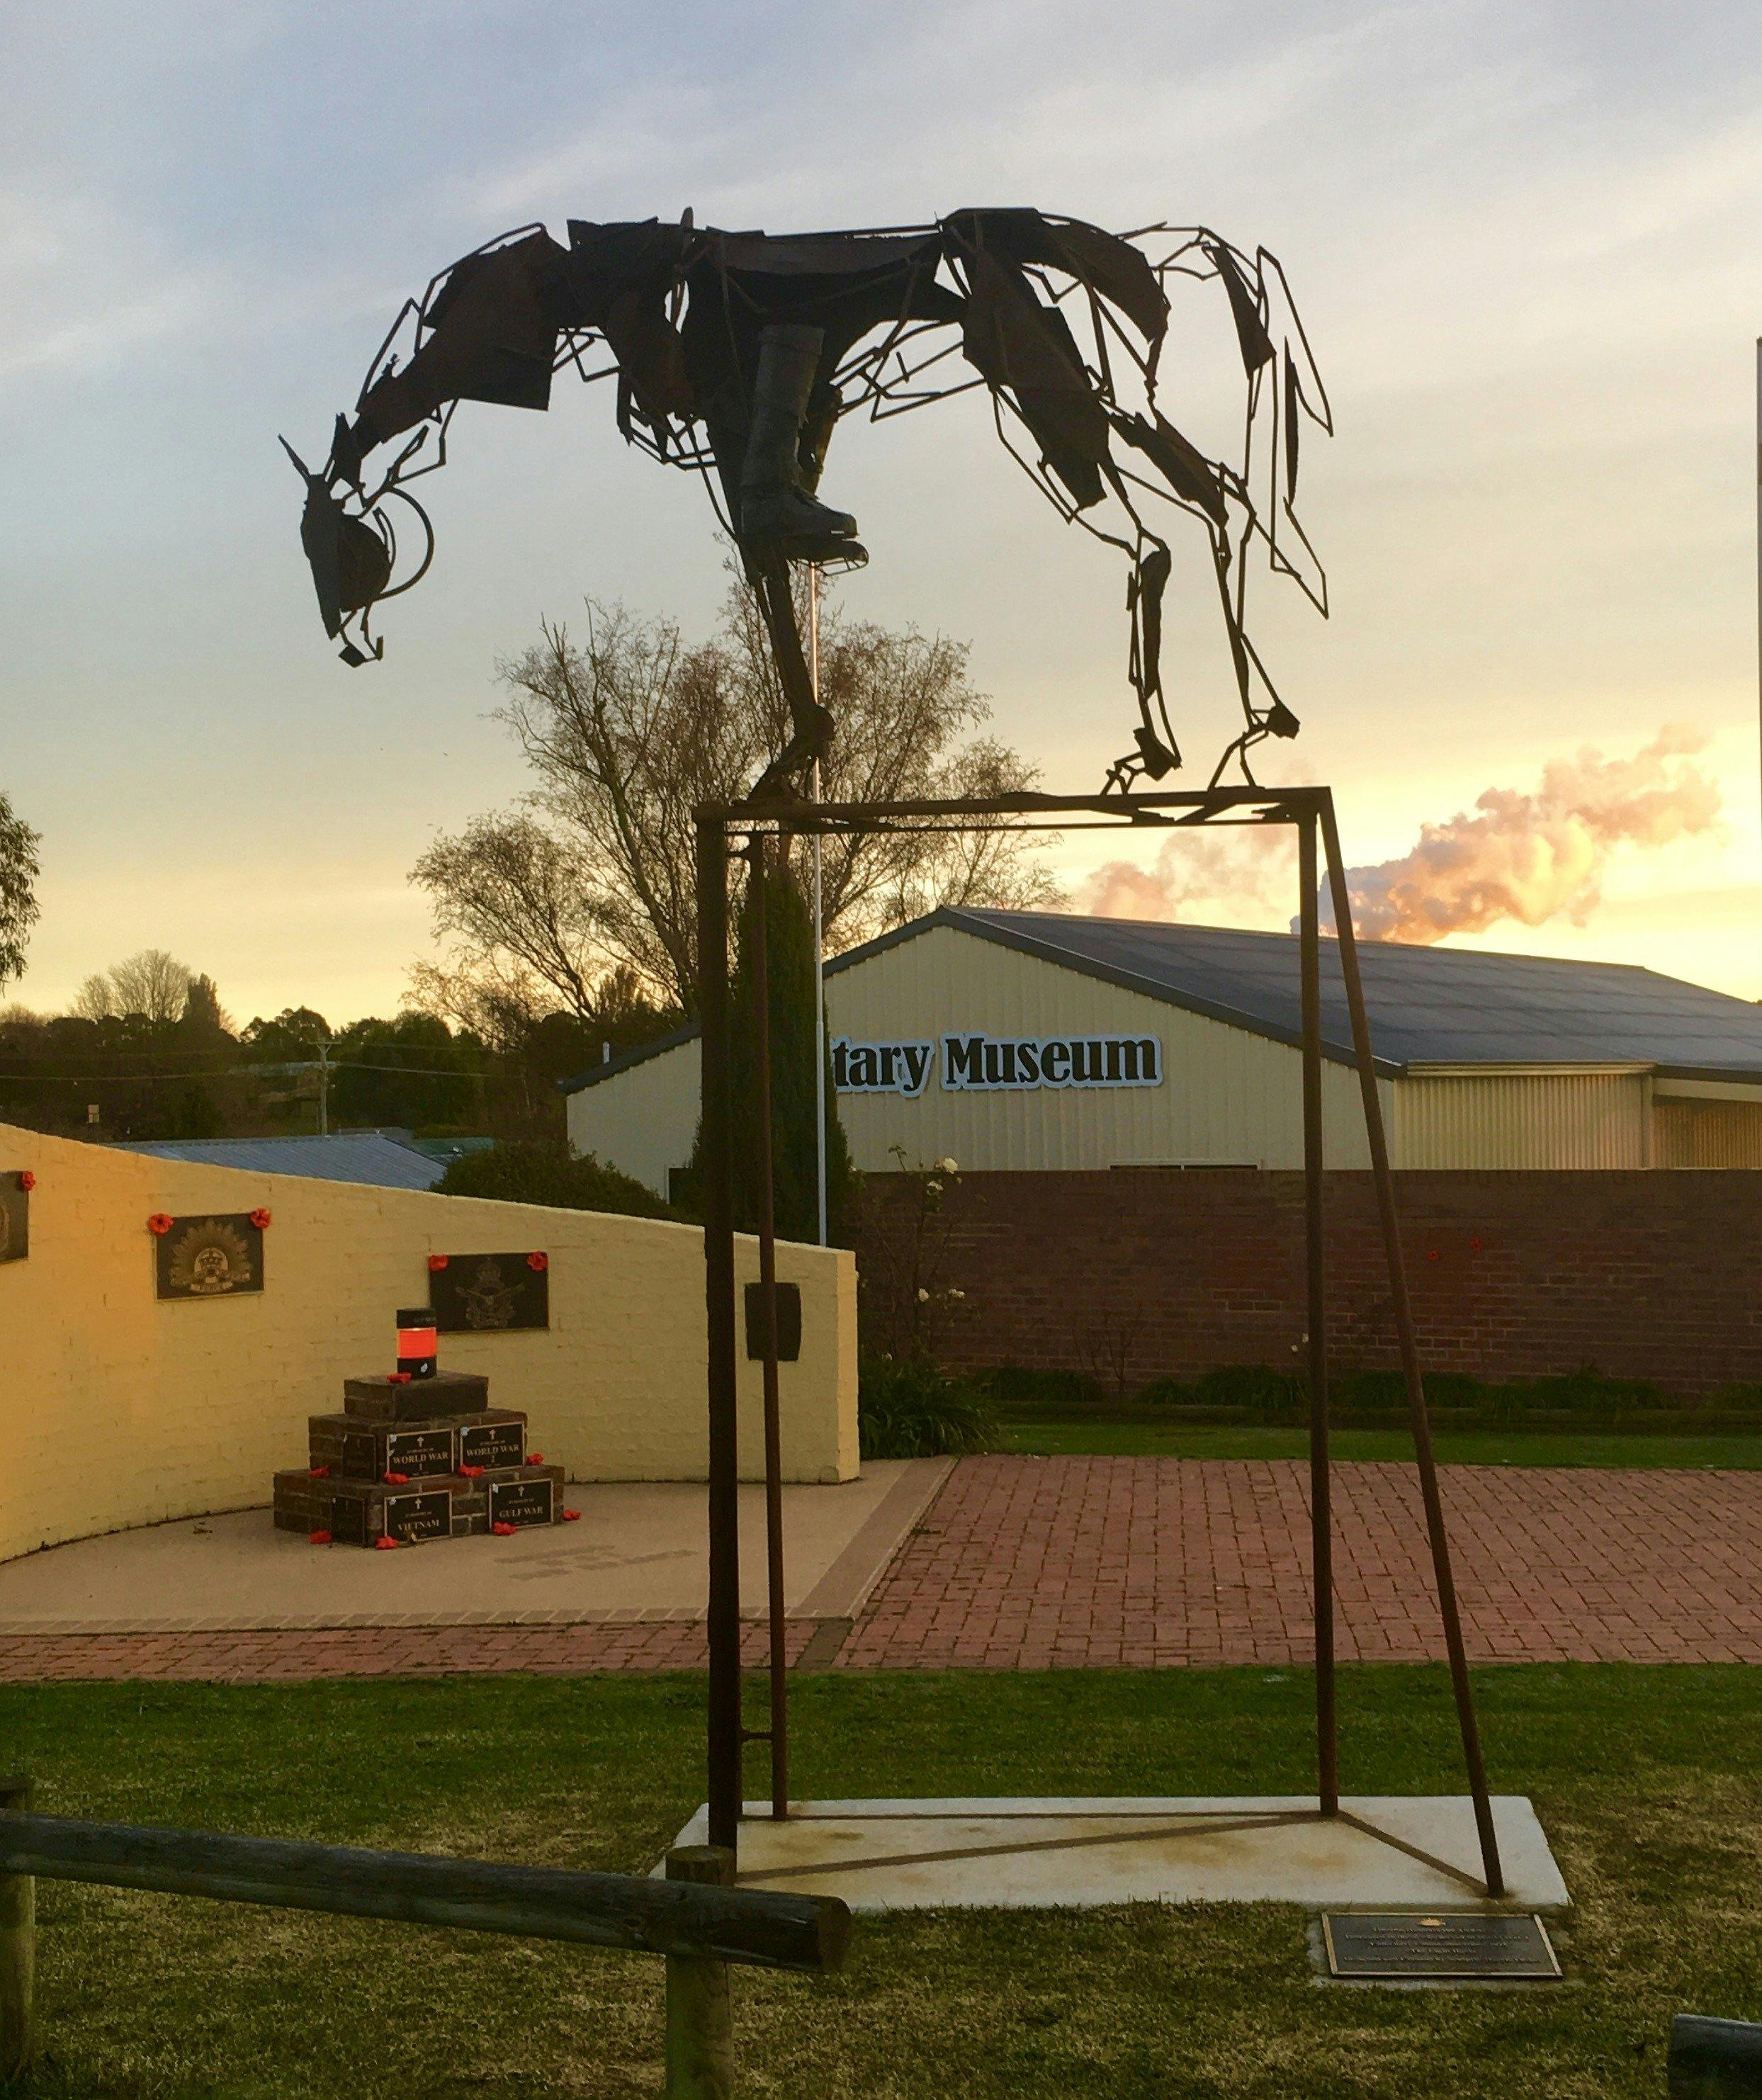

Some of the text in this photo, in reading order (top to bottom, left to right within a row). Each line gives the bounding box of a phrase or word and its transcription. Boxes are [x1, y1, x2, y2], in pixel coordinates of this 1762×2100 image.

[945, 1037, 1158, 1084] Museum
[466, 1444, 520, 1457] WORLD WAR
[393, 1454, 427, 1464] WORLD
[428, 1451, 449, 1461] WAR
[524, 1506, 544, 1515] WAR
[397, 1519, 440, 1531] VIETNAM
